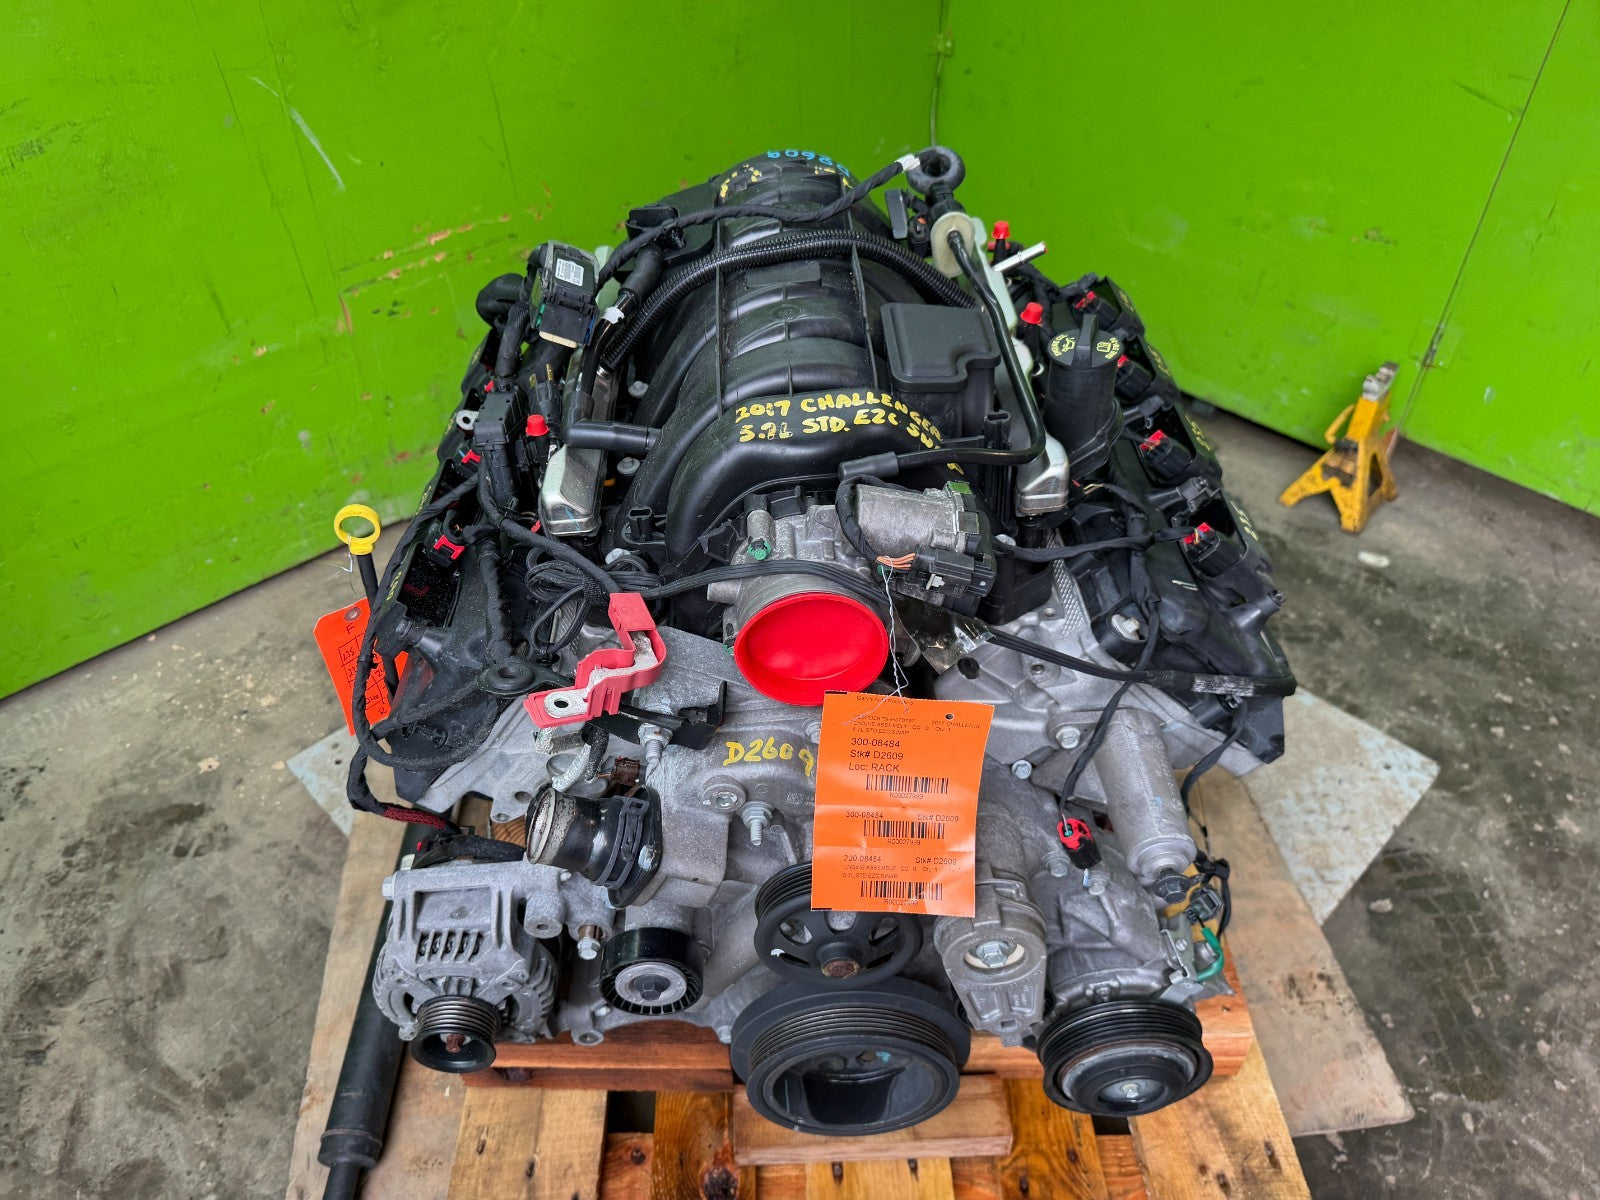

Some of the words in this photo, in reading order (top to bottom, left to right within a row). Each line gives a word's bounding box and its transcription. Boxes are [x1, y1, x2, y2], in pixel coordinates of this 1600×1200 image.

[735, 400, 791, 423] 2017
[800, 391, 943, 442] CHALLENGER
[851, 737, 900, 748] 300-08484
[723, 736, 814, 777] D2609
[850, 749, 871, 758] Stk#
[873, 751, 904, 760] D2609
[848, 762, 868, 771] Loc:
[871, 763, 900, 772] RACK
[846, 811, 883, 819] 300-08484
[933, 857, 957, 865] D2609
